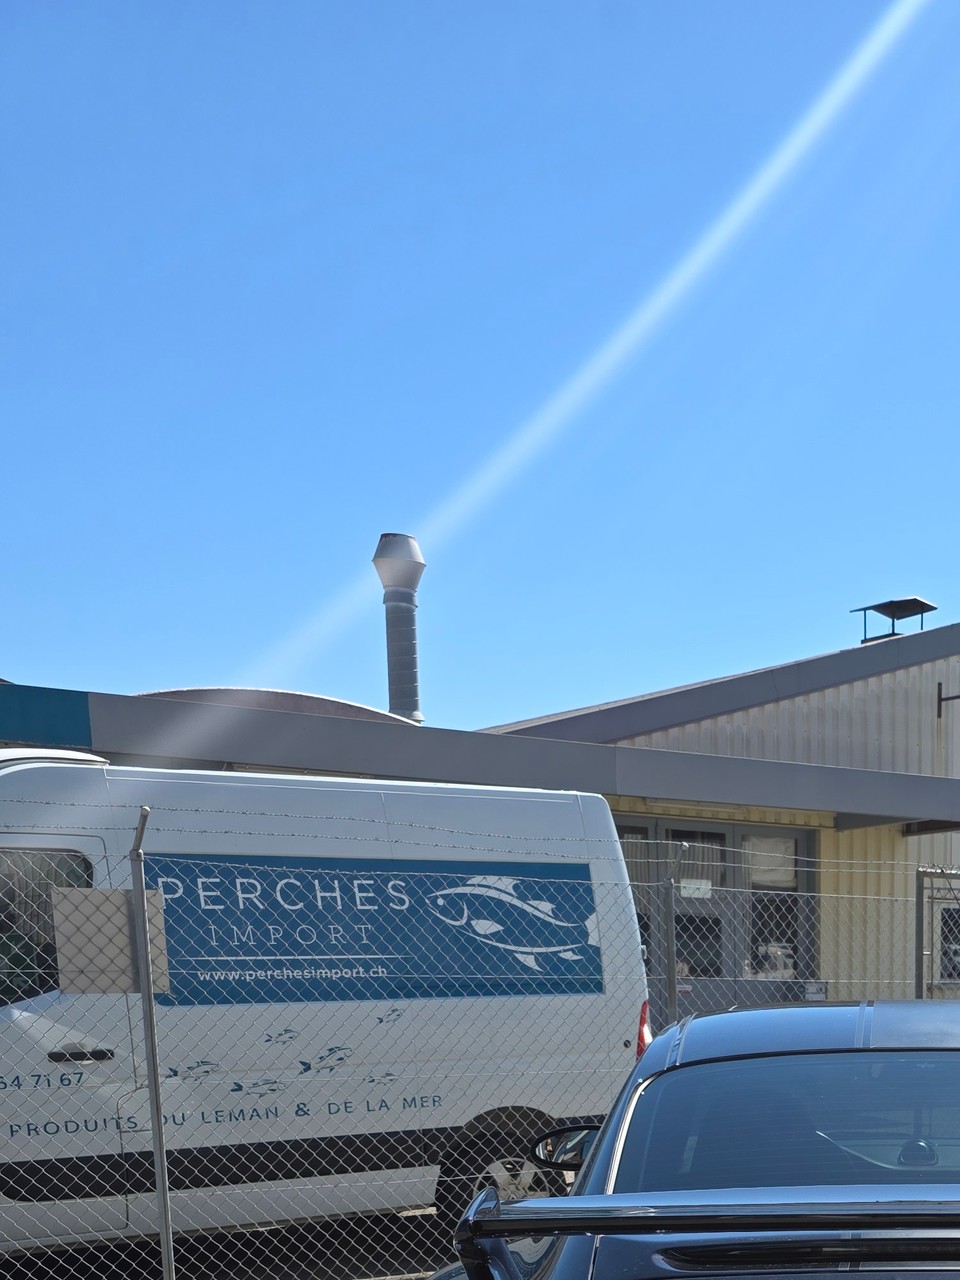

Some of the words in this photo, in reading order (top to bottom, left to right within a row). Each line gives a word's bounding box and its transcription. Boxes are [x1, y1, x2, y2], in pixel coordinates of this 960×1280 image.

[157, 877, 410, 910] PERCHES
[208, 924, 374, 946] IMPORT
[197, 965, 388, 982] www.perchesimport.ch
[31, 1073, 51, 1088] 71
[60, 1072, 84, 1087] 67
[9, 1115, 138, 1138] PRODUITS
[201, 1106, 279, 1124] LEMAN
[294, 1102, 311, 1117] &
[327, 1101, 353, 1115] DE
[366, 1099, 391, 1112] LA
[402, 1095, 442, 1110] MER
